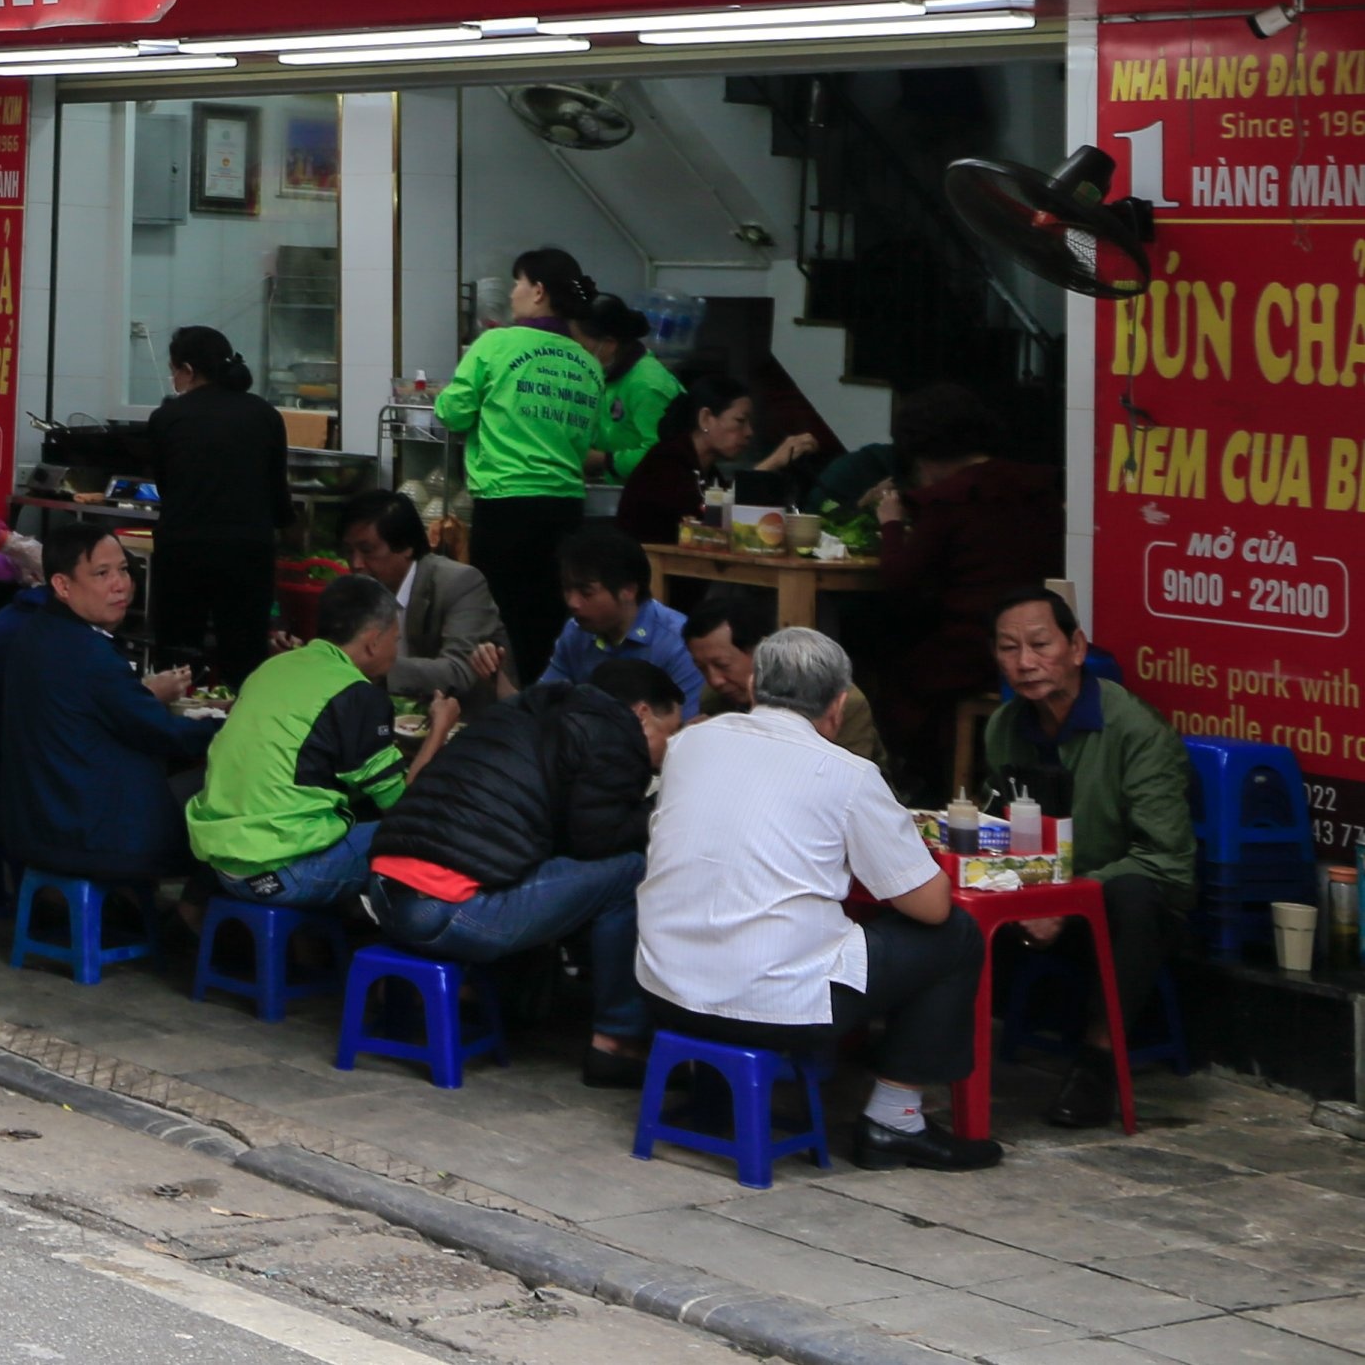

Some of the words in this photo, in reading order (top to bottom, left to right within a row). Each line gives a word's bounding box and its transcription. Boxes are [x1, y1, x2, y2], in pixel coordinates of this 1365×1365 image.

[1175, 43, 1261, 100] HÀNG
[1266, 27, 1329, 98] ĐẮC
[1220, 111, 1295, 140] Since
[1113, 120, 1180, 208] 1
[1191, 156, 1280, 208] HÀNG
[1110, 250, 1237, 382] BÚN
[1107, 422, 1208, 500] NEM
[1221, 429, 1313, 509] CUA
[1186, 526, 1237, 560] MỞ
[1242, 529, 1298, 567] CỬA
[1162, 568, 1224, 607] 9h00
[1248, 578, 1330, 619] 22h00
[1136, 645, 1218, 690] Grilles
[1227, 658, 1290, 701] pork
[1299, 667, 1361, 709] with
[1172, 703, 1263, 743] noodle
[1272, 715, 1333, 757] crab
